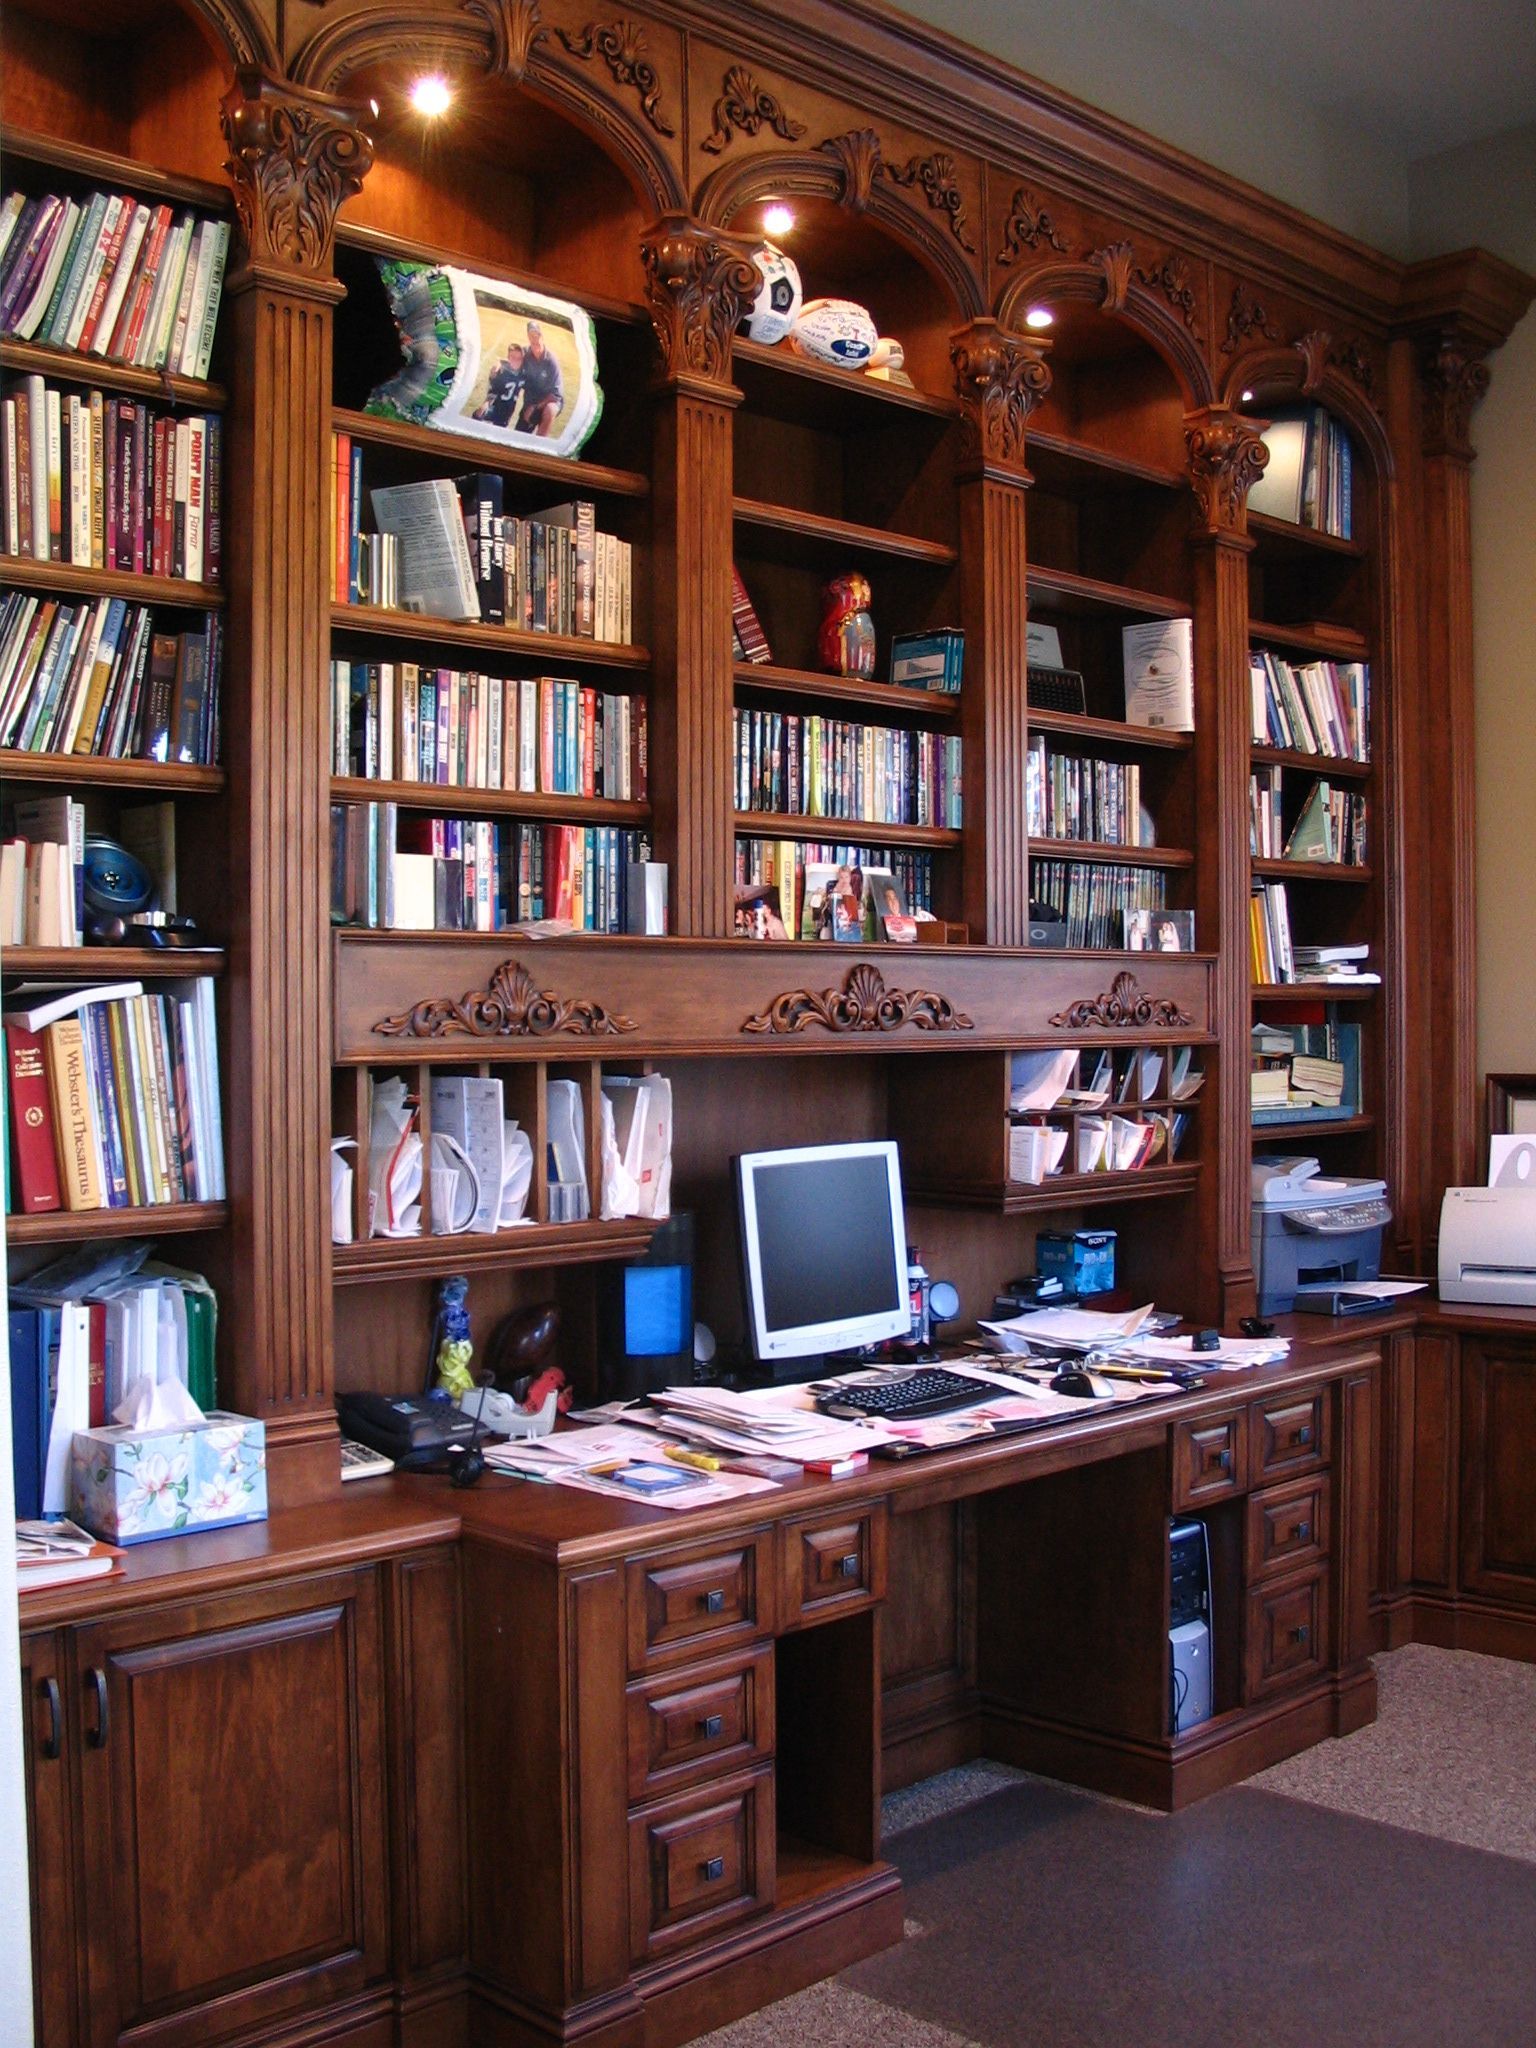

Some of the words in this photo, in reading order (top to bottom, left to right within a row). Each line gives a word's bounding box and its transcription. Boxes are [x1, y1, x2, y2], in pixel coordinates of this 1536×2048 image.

[213, 255, 222, 267] THE
[211, 271, 220, 284] MEN
[208, 286, 217, 303] THEY
[205, 305, 214, 321] WILL
[91, 415, 99, 434] SEVEN
[90, 437, 99, 468] PROMISES
[190, 430, 201, 473] POINT
[93, 486, 101, 513] PROMISE
[189, 476, 200, 508] MAN
[93, 516, 102, 539] KEEPER
[188, 514, 200, 549] Farrar
[480, 501, 492, 537] Without
[493, 517, 504, 535] Tom
[577, 507, 591, 550] DUNE
[209, 518, 220, 554] WARREN
[480, 539, 493, 580] Remorse
[492, 537, 504, 568] Clancy
[583, 559, 591, 585] FRANK
[582, 586, 590, 623] HERBERT
[64, 1049, 85, 1116] Webster's
[71, 1116, 93, 1195] Thesaurus
